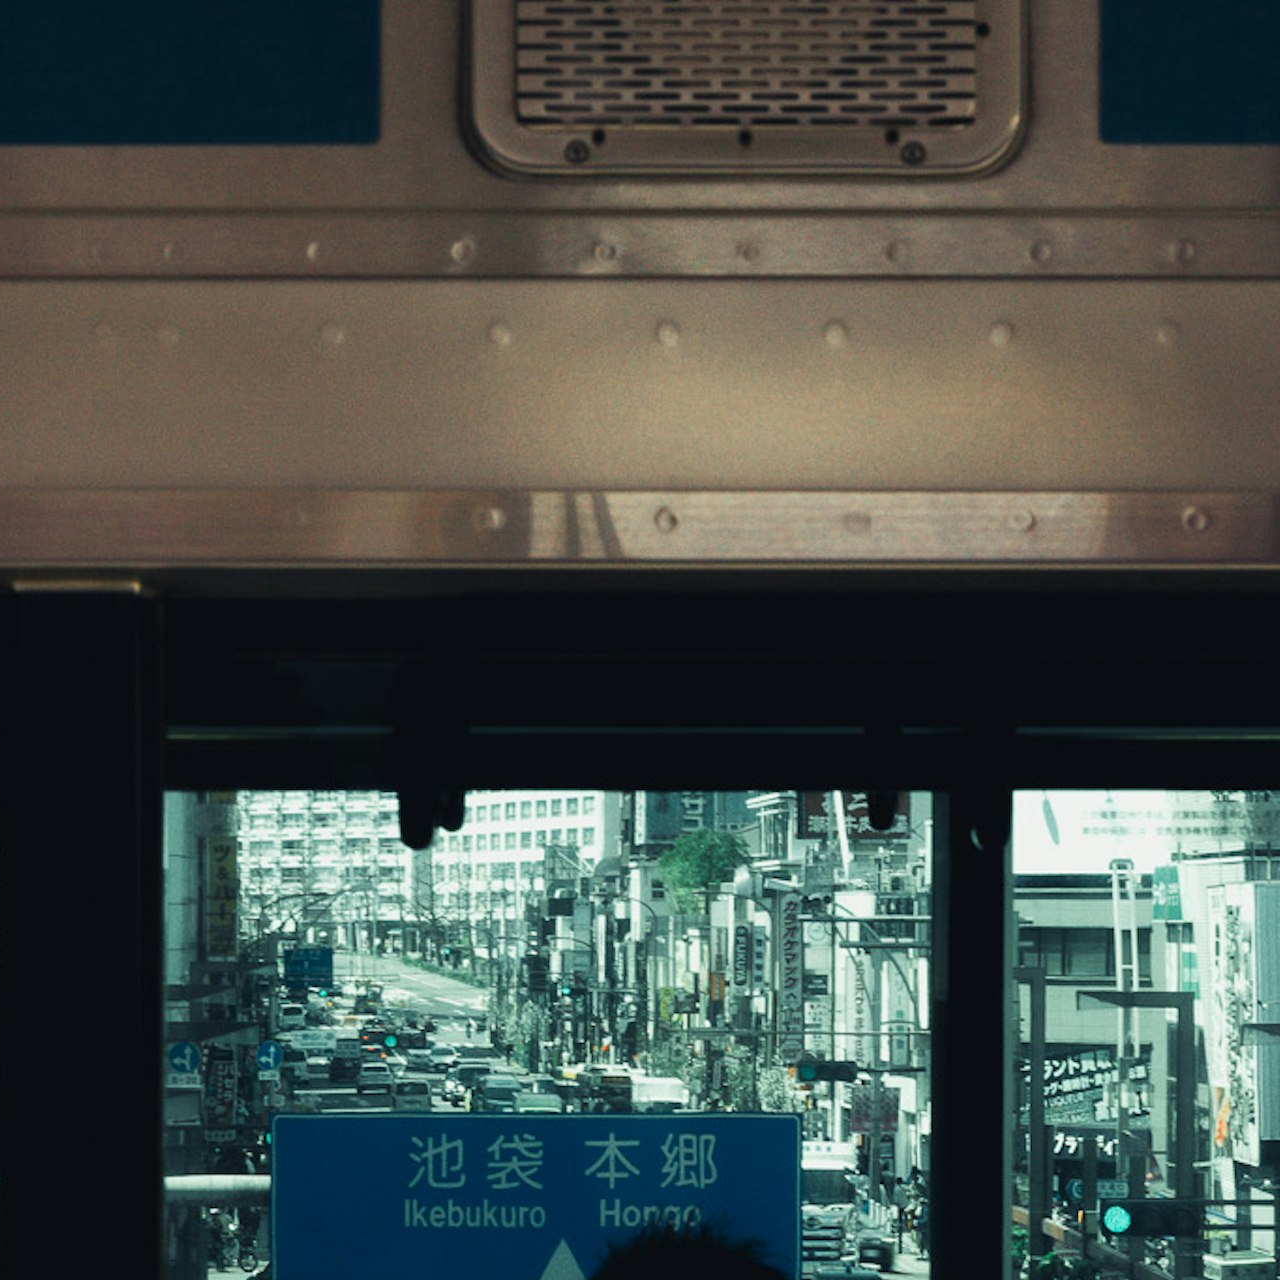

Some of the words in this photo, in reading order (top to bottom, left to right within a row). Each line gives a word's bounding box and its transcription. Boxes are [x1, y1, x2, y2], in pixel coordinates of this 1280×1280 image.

[408, 1133, 544, 1189] 池袋
[585, 1133, 718, 1189] 本郷
[404, 1200, 546, 1228] Ikebukuro
